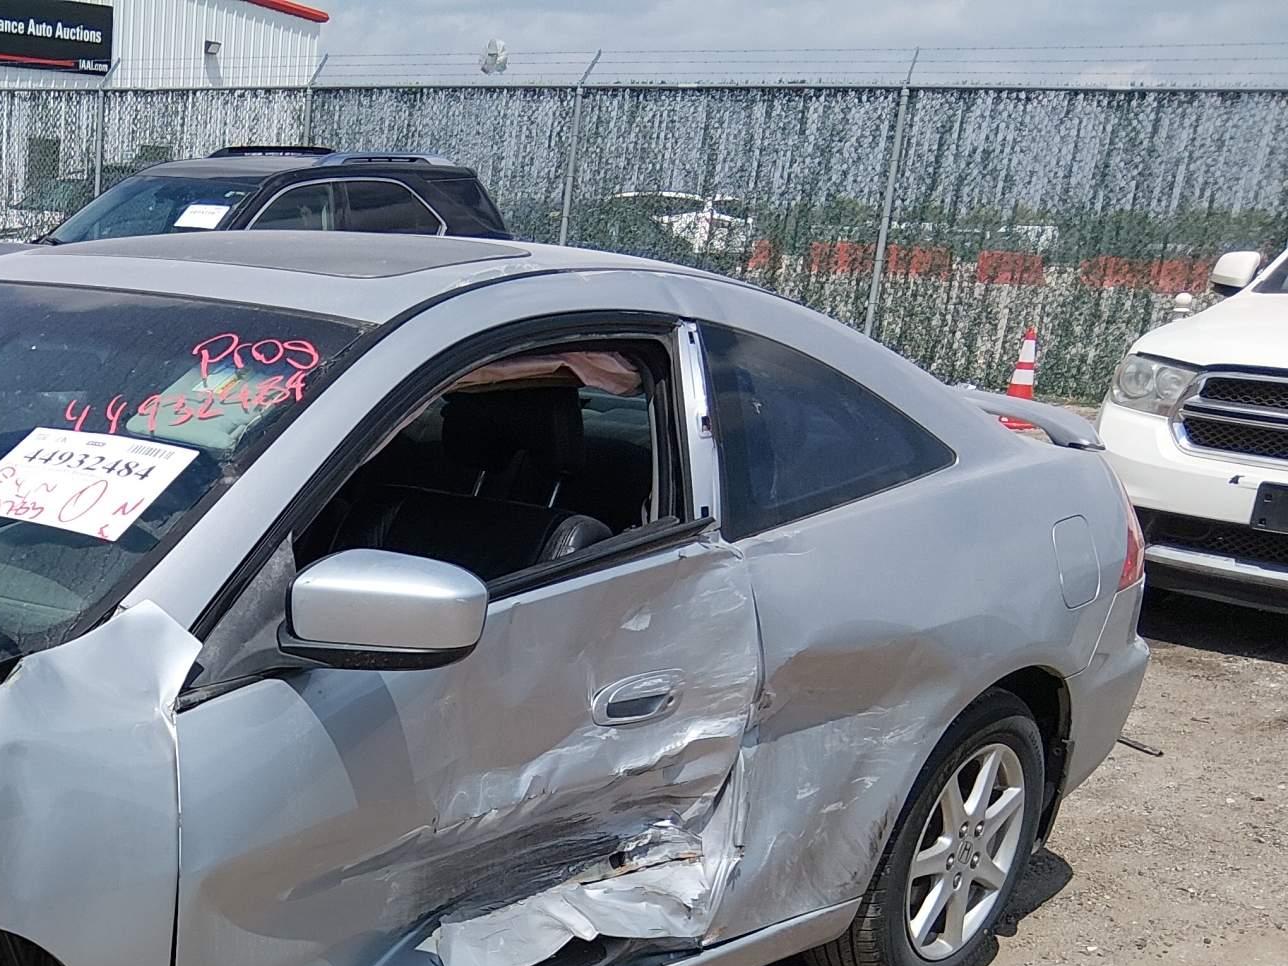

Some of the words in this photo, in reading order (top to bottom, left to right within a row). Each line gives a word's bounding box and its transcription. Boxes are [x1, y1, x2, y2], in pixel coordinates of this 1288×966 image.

[27, 18, 53, 39] Auto
[55, 22, 102, 44] Auctions
[24, 448, 156, 480] 44932484
